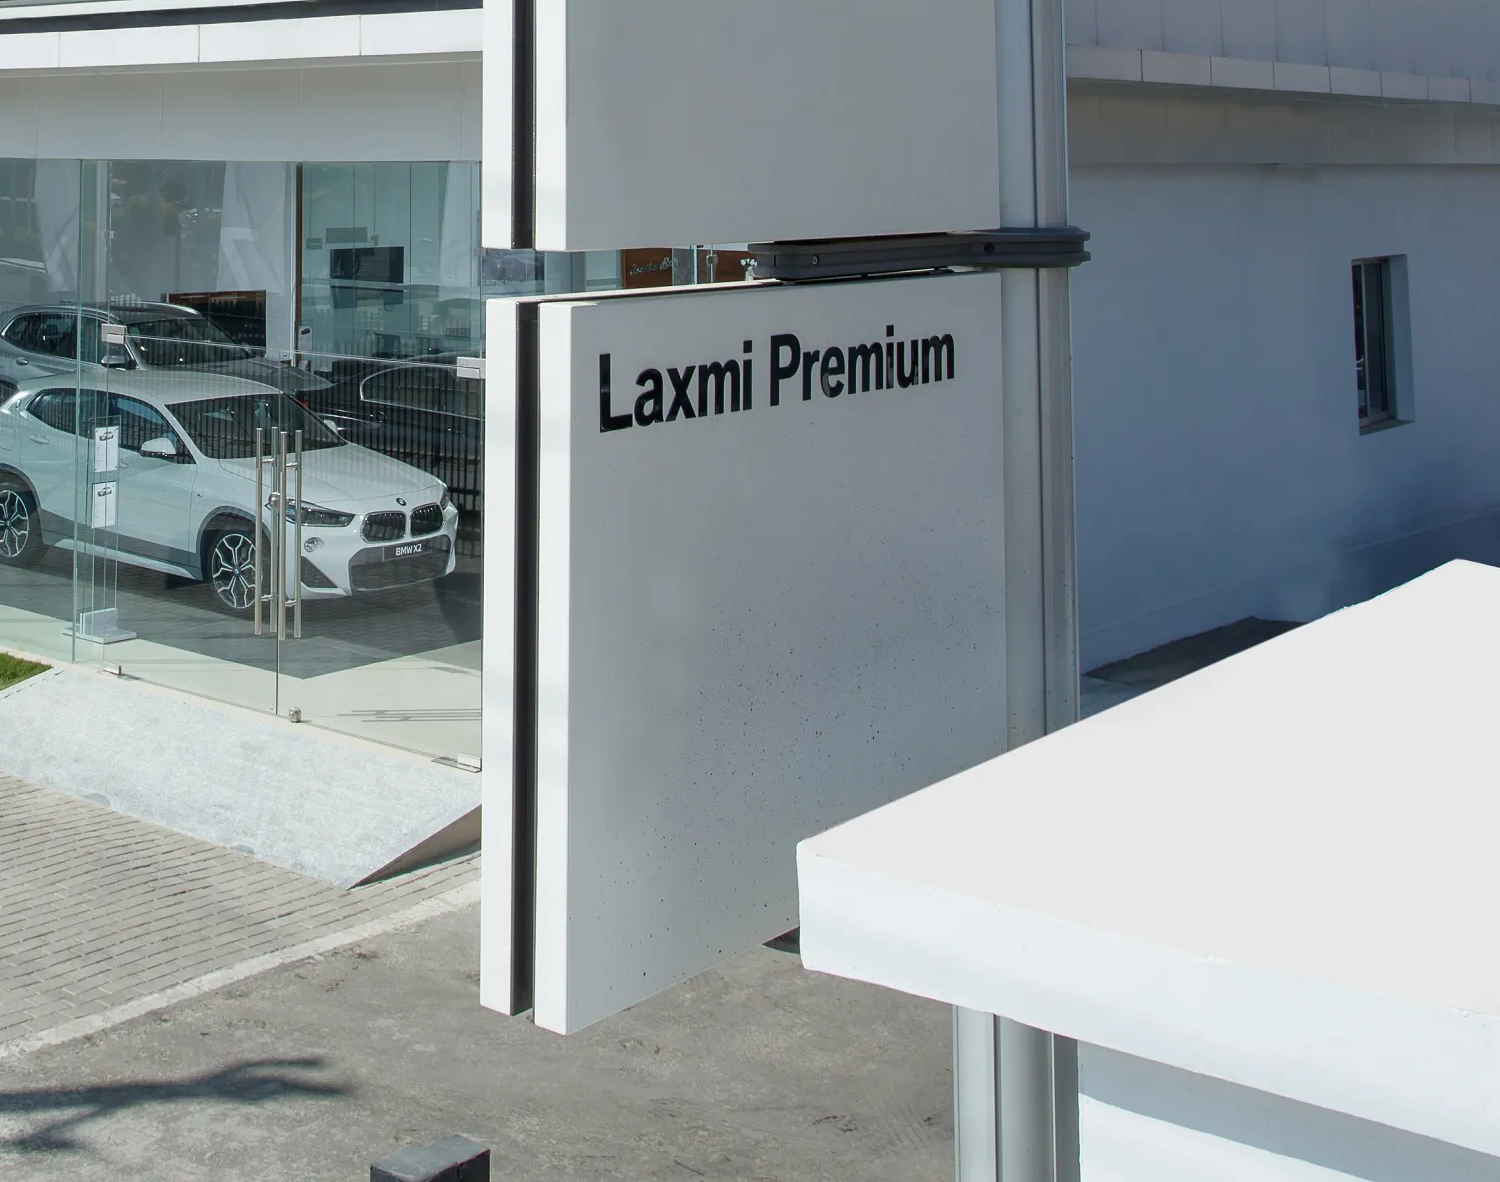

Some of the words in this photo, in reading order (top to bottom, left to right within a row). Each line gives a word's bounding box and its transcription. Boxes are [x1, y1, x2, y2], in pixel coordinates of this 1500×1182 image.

[599, 340, 753, 433] Laxmi
[770, 325, 955, 407] Premium
[396, 545, 413, 556] BMW
[413, 543, 422, 552] X2
